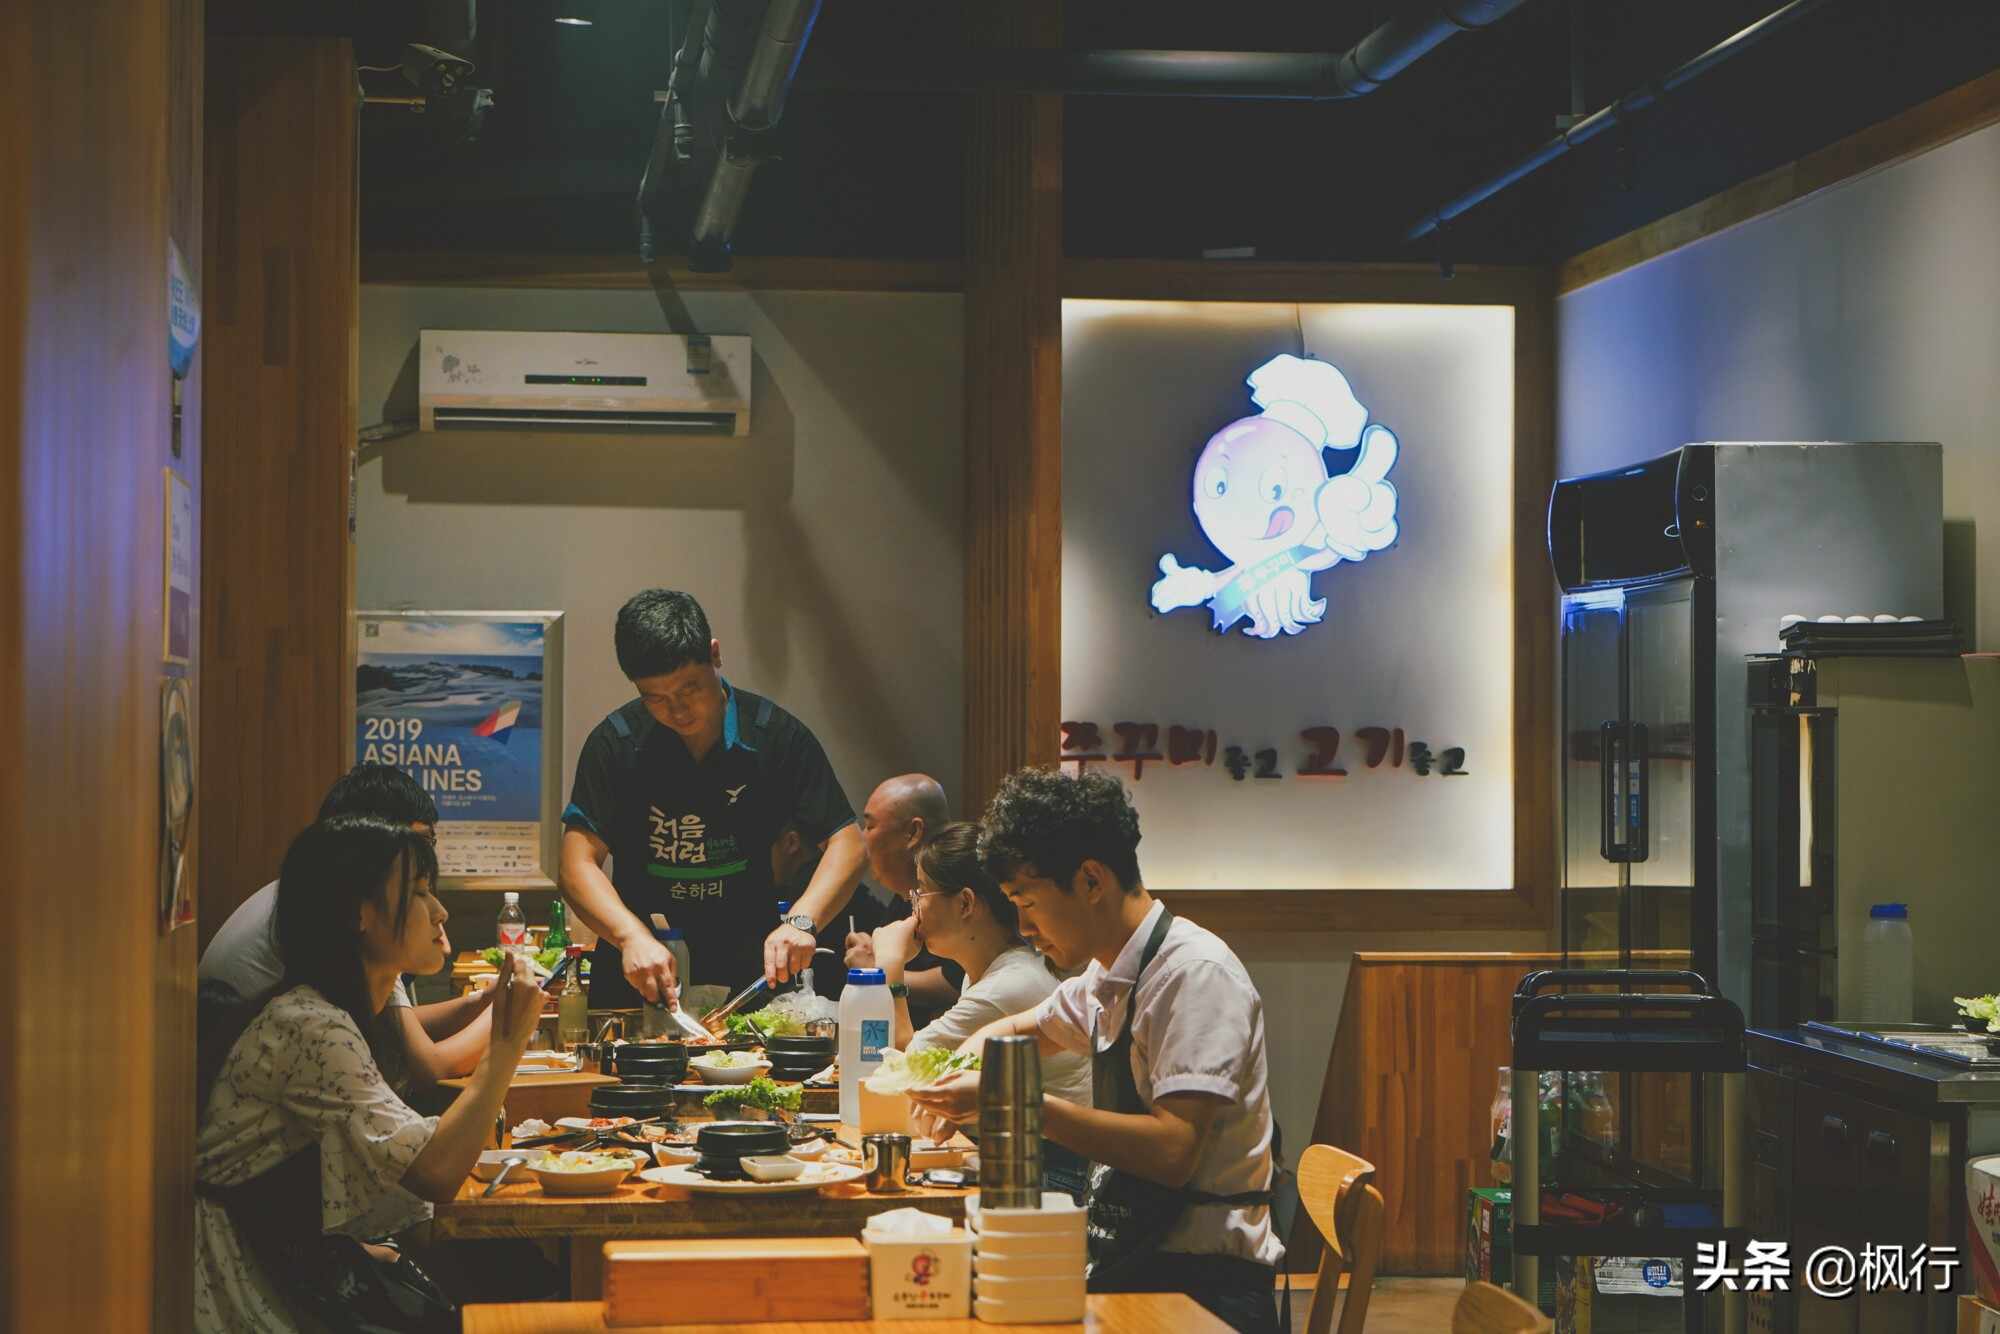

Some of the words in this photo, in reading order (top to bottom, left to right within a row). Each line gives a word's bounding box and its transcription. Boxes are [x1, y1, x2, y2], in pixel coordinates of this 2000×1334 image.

[364, 718, 423, 741] 2019
[363, 743, 462, 766] ASIANA
[649, 805, 706, 839] 처음
[649, 835, 707, 864] 처럼
[669, 879, 723, 901] 순하리
